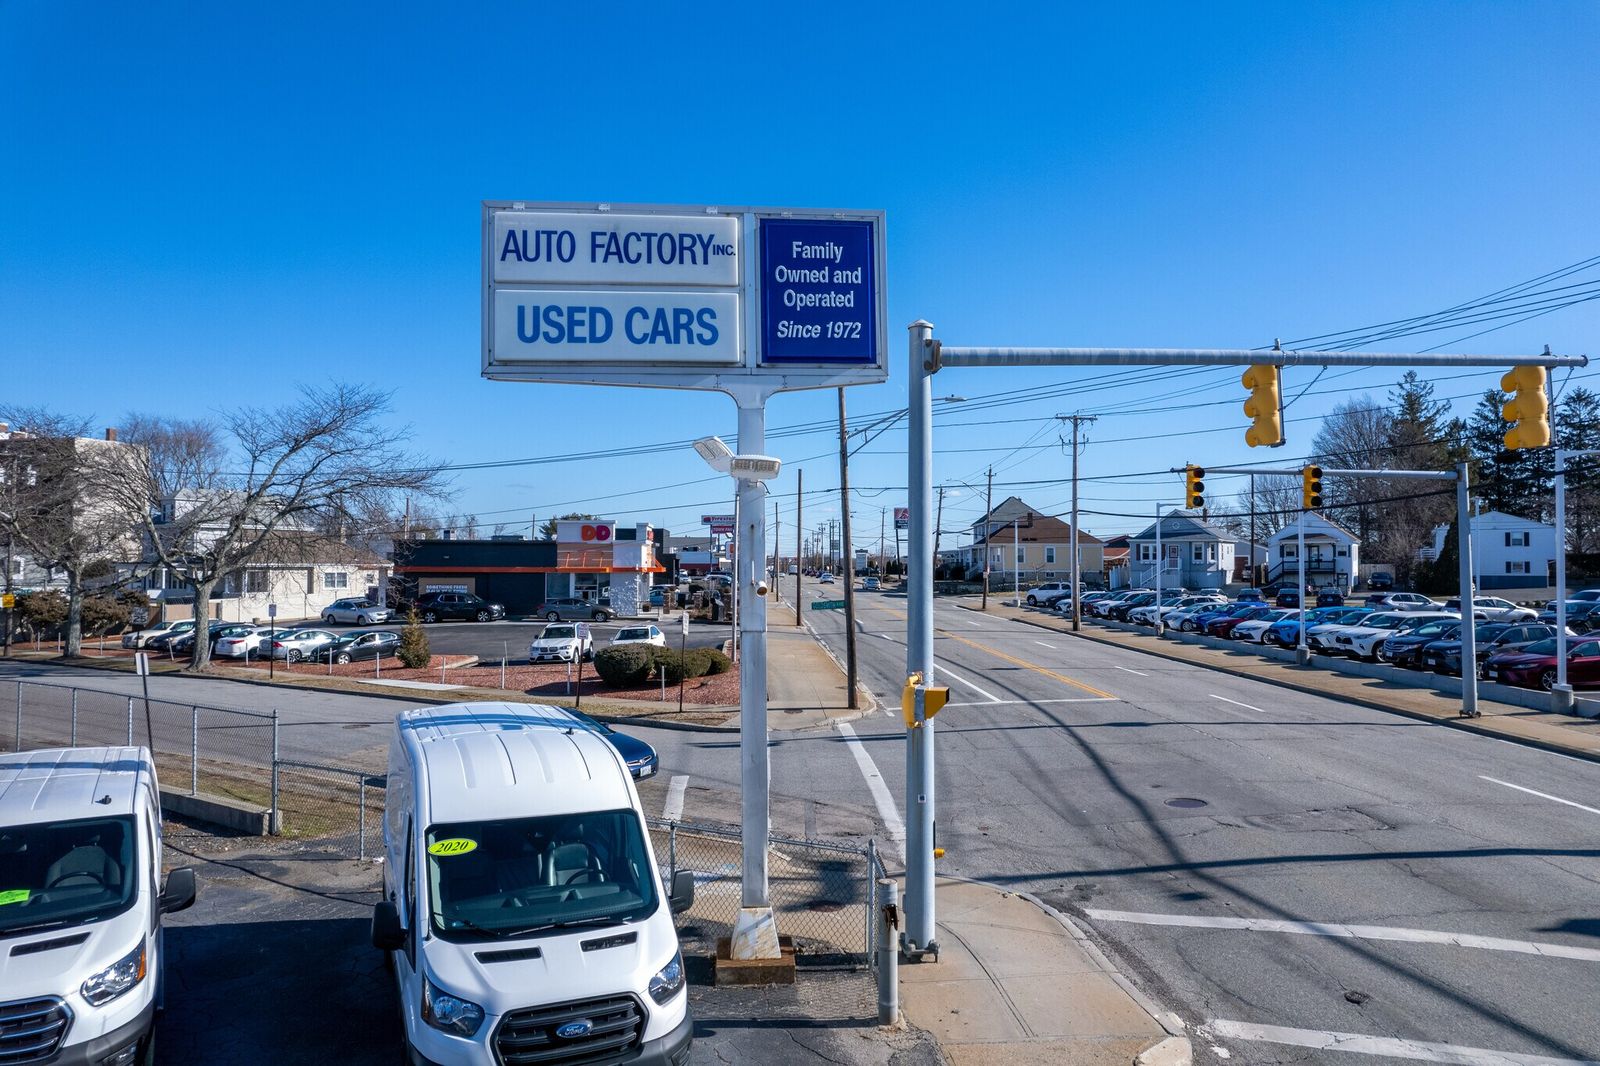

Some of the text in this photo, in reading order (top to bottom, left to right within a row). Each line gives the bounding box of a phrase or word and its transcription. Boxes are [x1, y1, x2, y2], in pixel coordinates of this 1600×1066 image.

[500, 229, 736, 265] AUTO FACTORY INC.
[792, 241, 843, 264] Family
[775, 265, 862, 284] Owned and
[783, 289, 854, 311] Operated
[517, 304, 719, 346] USED CARS
[777, 320, 861, 339] Since 1972
[435, 841, 469, 852] 2020
